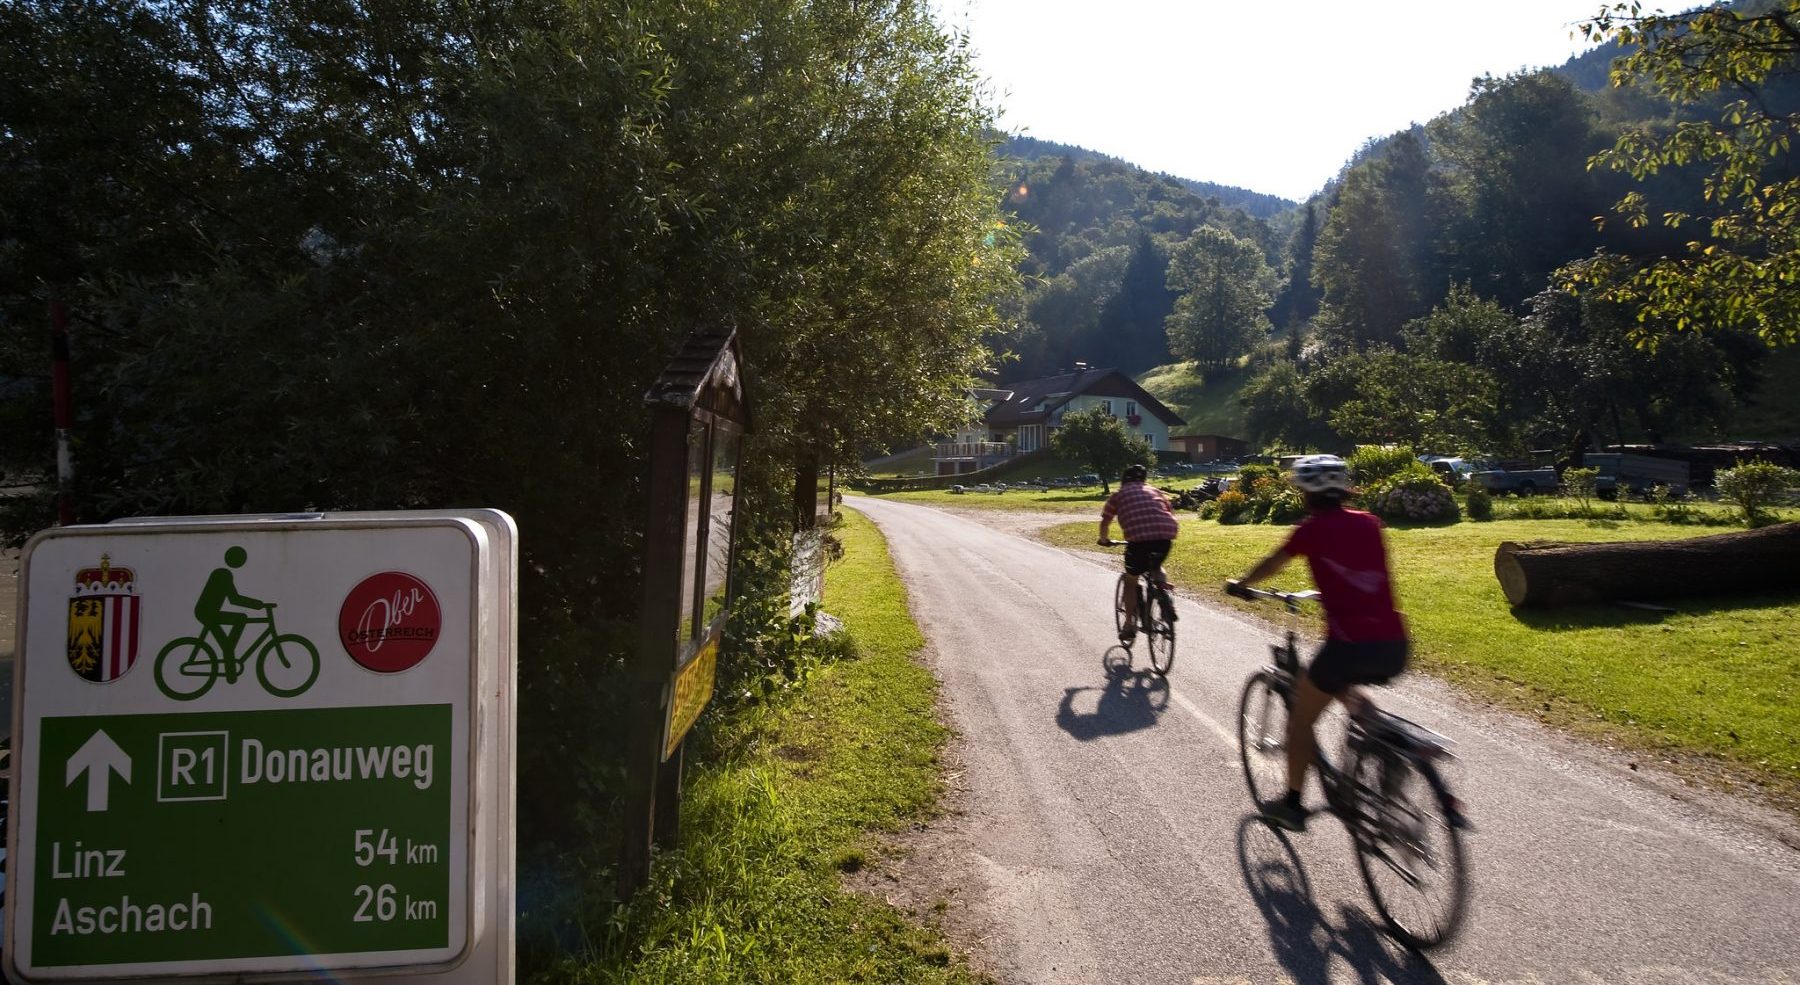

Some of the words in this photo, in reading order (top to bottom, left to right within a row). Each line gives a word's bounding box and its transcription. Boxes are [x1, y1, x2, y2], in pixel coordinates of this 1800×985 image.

[348, 626, 434, 642] ÖSTERREICH
[357, 587, 424, 652] Ober
[171, 747, 214, 785] R1
[240, 738, 434, 790] Donauweg
[51, 842, 127, 879] Linz
[353, 828, 399, 867] 54
[406, 839, 438, 865] km
[50, 893, 212, 935] Aschach
[352, 883, 397, 922] 26
[405, 894, 437, 921] km
